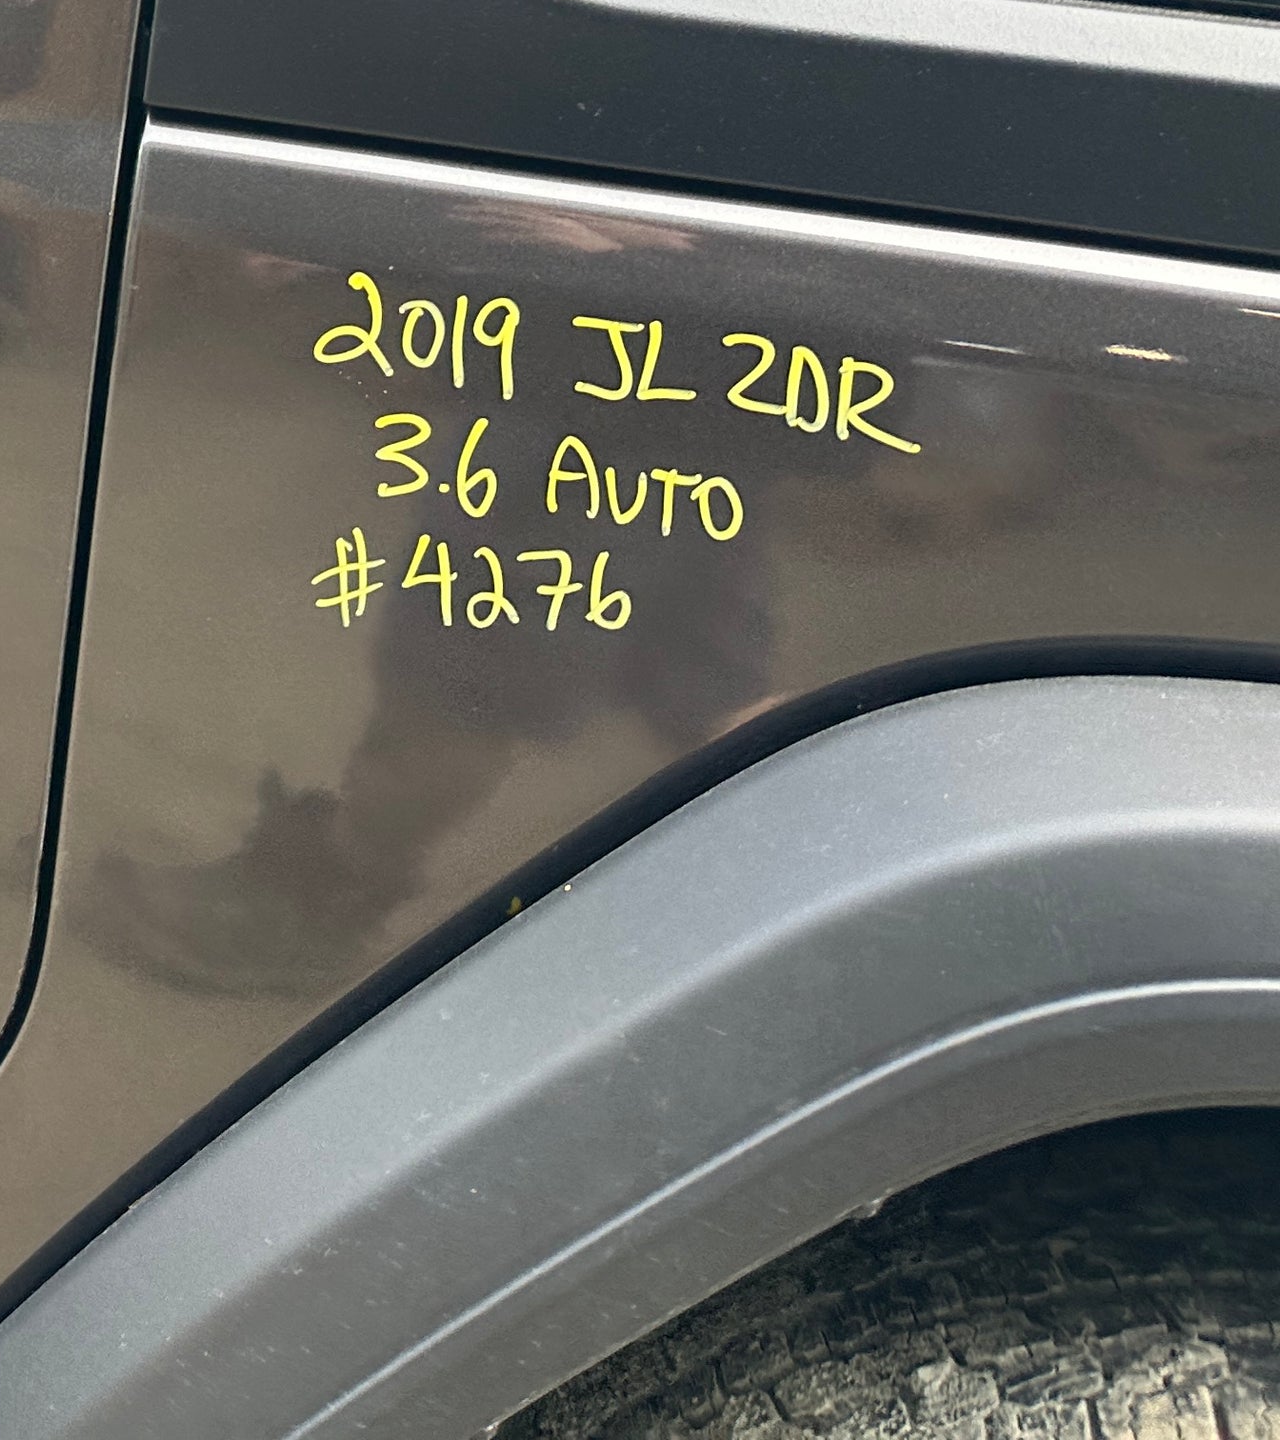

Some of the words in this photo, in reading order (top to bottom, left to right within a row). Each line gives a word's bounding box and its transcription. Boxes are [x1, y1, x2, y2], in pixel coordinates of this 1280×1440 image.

[312, 271, 520, 401] 2019
[572, 315, 697, 402] JL
[721, 333, 922, 453] 2DR
[375, 413, 498, 518] 3.6
[546, 436, 745, 542] AUTO
[311, 527, 633, 631] #4276
